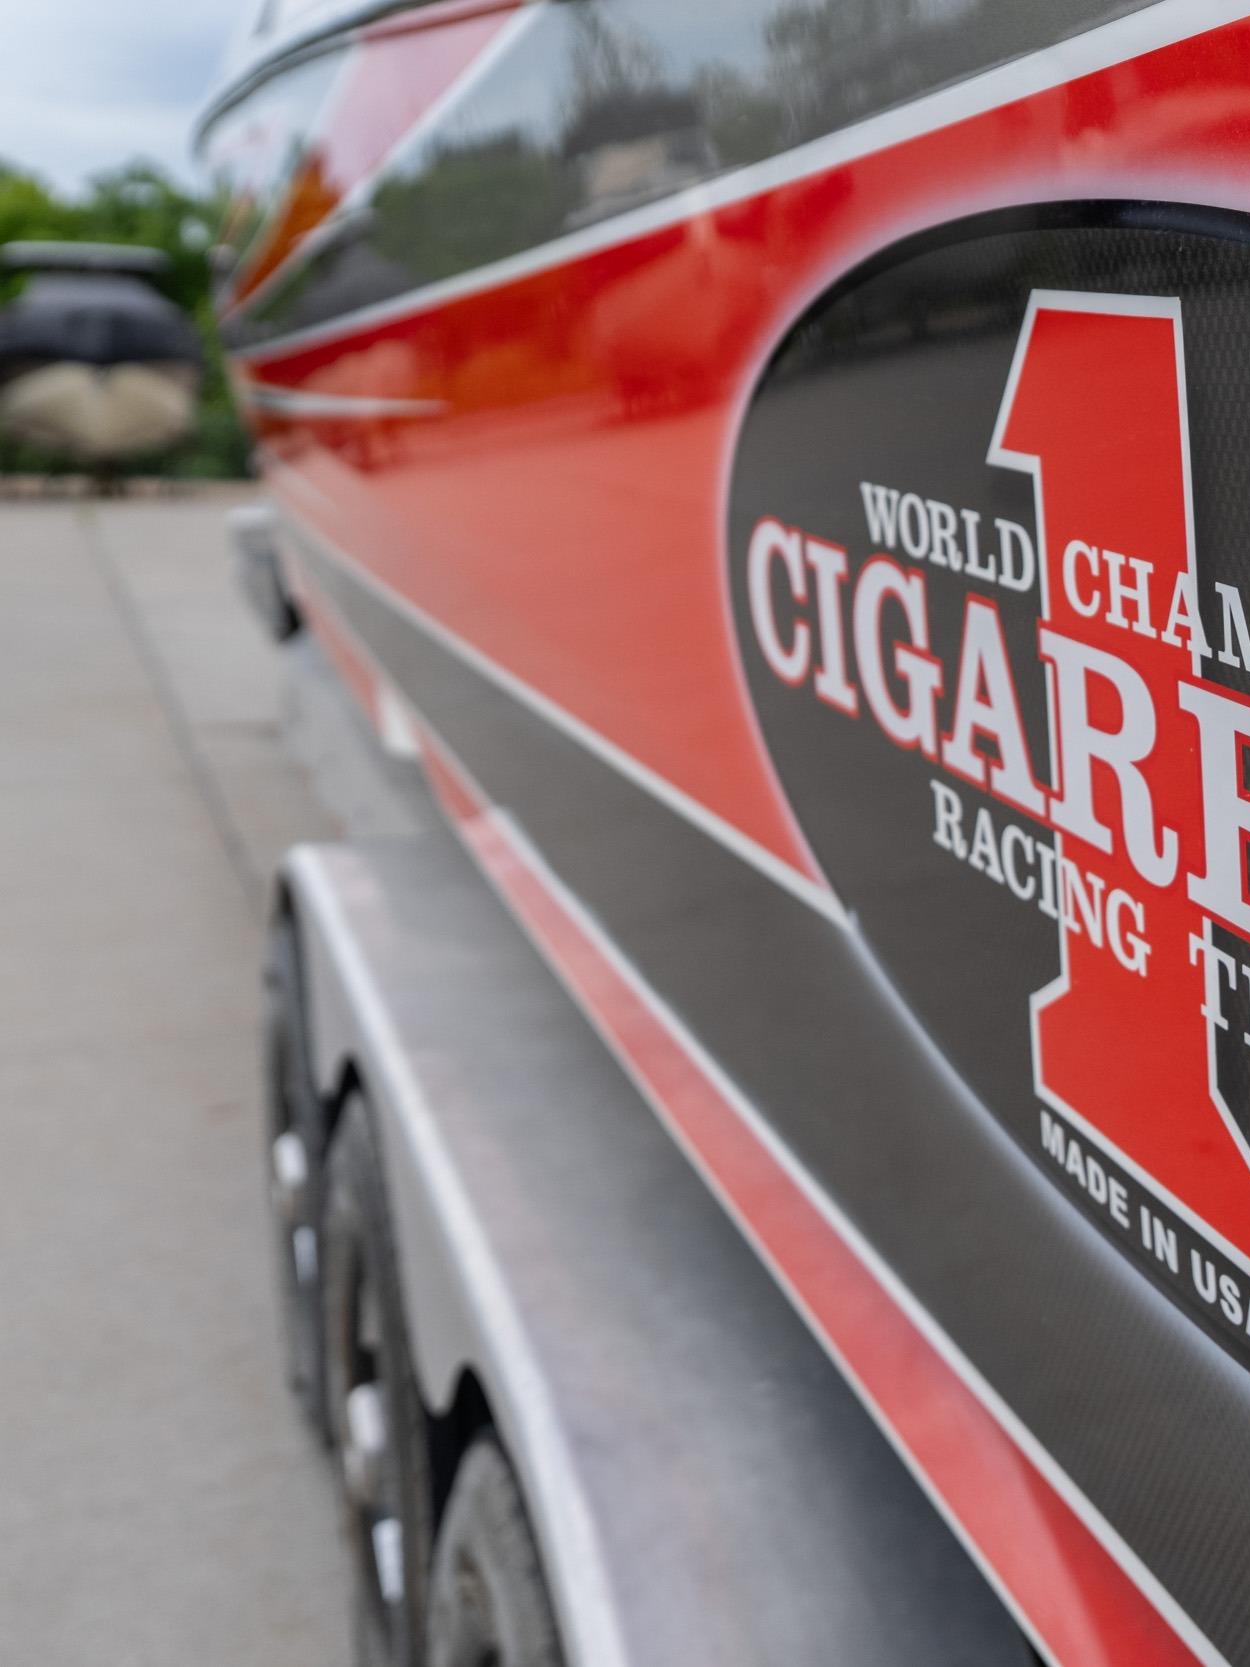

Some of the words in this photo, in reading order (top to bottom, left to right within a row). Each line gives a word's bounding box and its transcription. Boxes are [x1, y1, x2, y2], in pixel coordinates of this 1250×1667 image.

[860, 481, 1036, 592] WORLD
[931, 780, 1151, 977] RACING
[1040, 1110, 1130, 1229] MADE
[1141, 1208, 1179, 1274] IN
